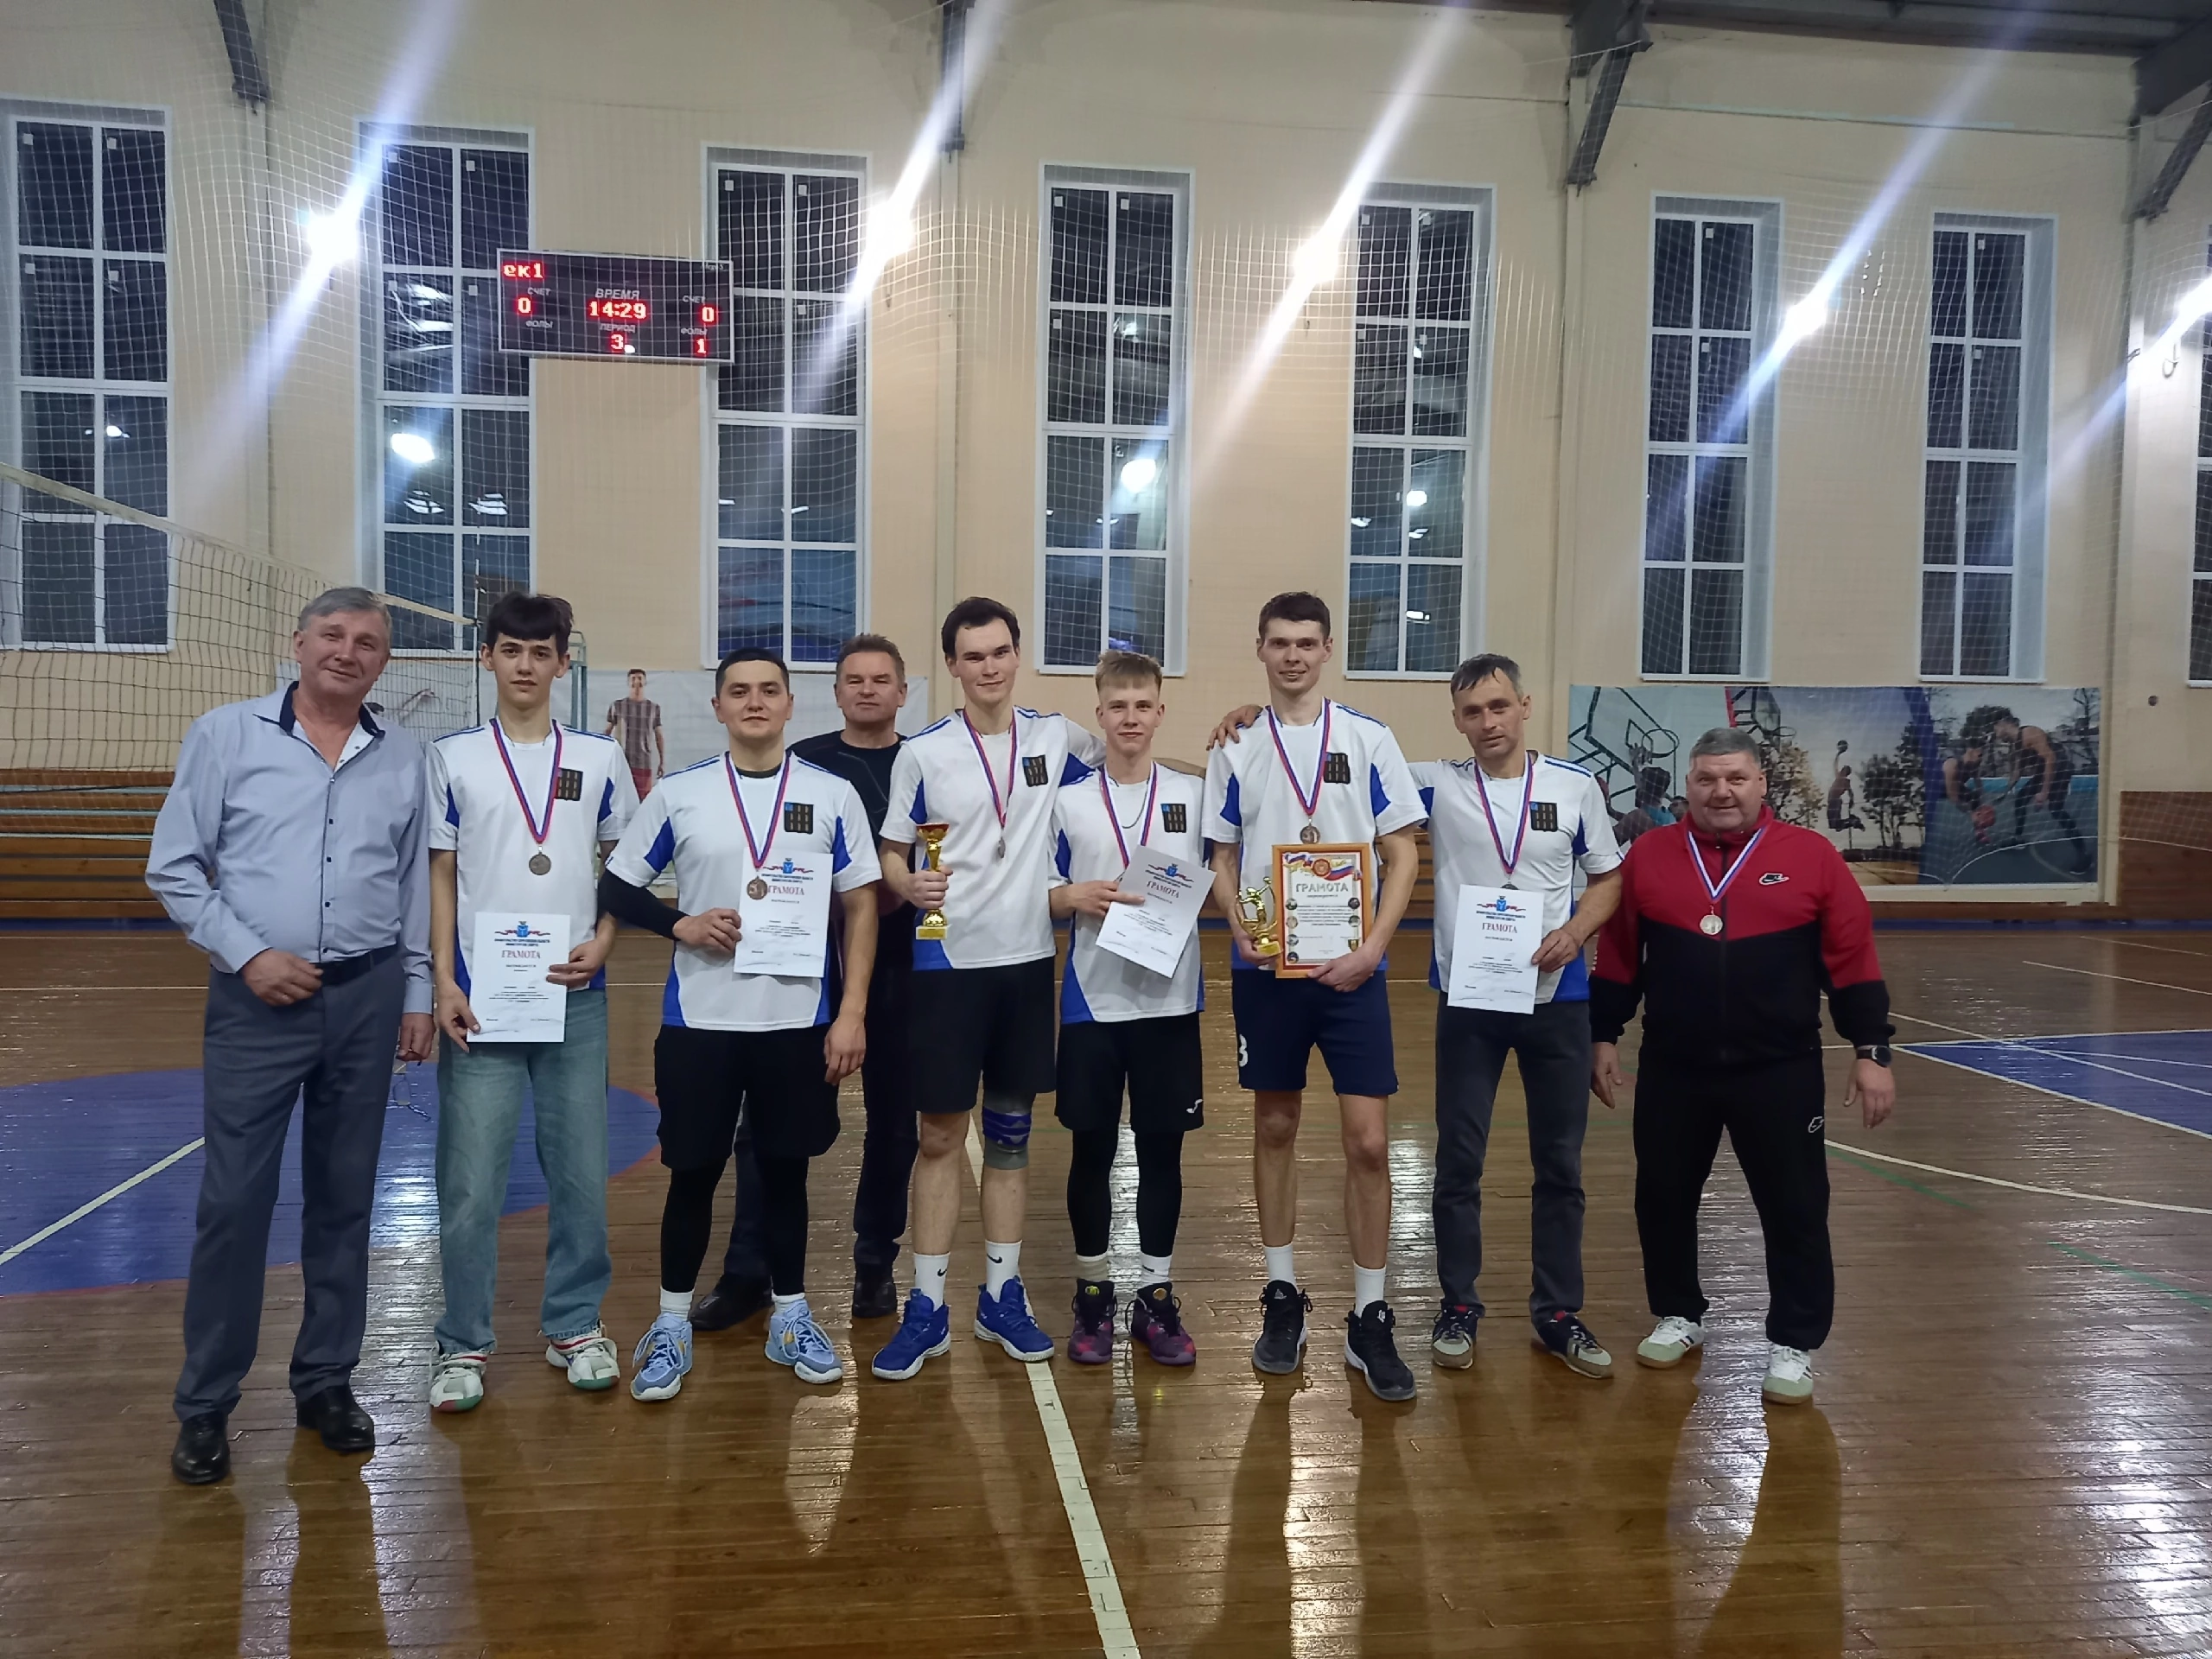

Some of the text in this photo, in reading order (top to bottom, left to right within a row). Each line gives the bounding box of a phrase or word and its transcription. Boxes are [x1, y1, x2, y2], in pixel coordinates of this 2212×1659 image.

[527, 287, 551, 296] СЧЕТ
[594, 288, 640, 300] ВРЕМЯ
[518, 297, 531, 314] 0
[682, 295, 706, 304] СЧЕТ
[589, 301, 647, 320] 14:29
[702, 306, 715, 322] 0
[525, 320, 554, 329] ФОЛЫ
[599, 322, 636, 334] ПЕРИОД
[680, 327, 709, 336] ФОЛЫ
[610, 334, 624, 350] 3
[696, 338, 707, 354] 1
[767, 885, 805, 896] ГРАМОТА
[1146, 880, 1179, 899] ГРАМОТА
[1295, 882, 1349, 893] ГРАМОТА
[1482, 922, 1518, 934] ГРАМОТА
[501, 950, 541, 959] ГРАМОТА
